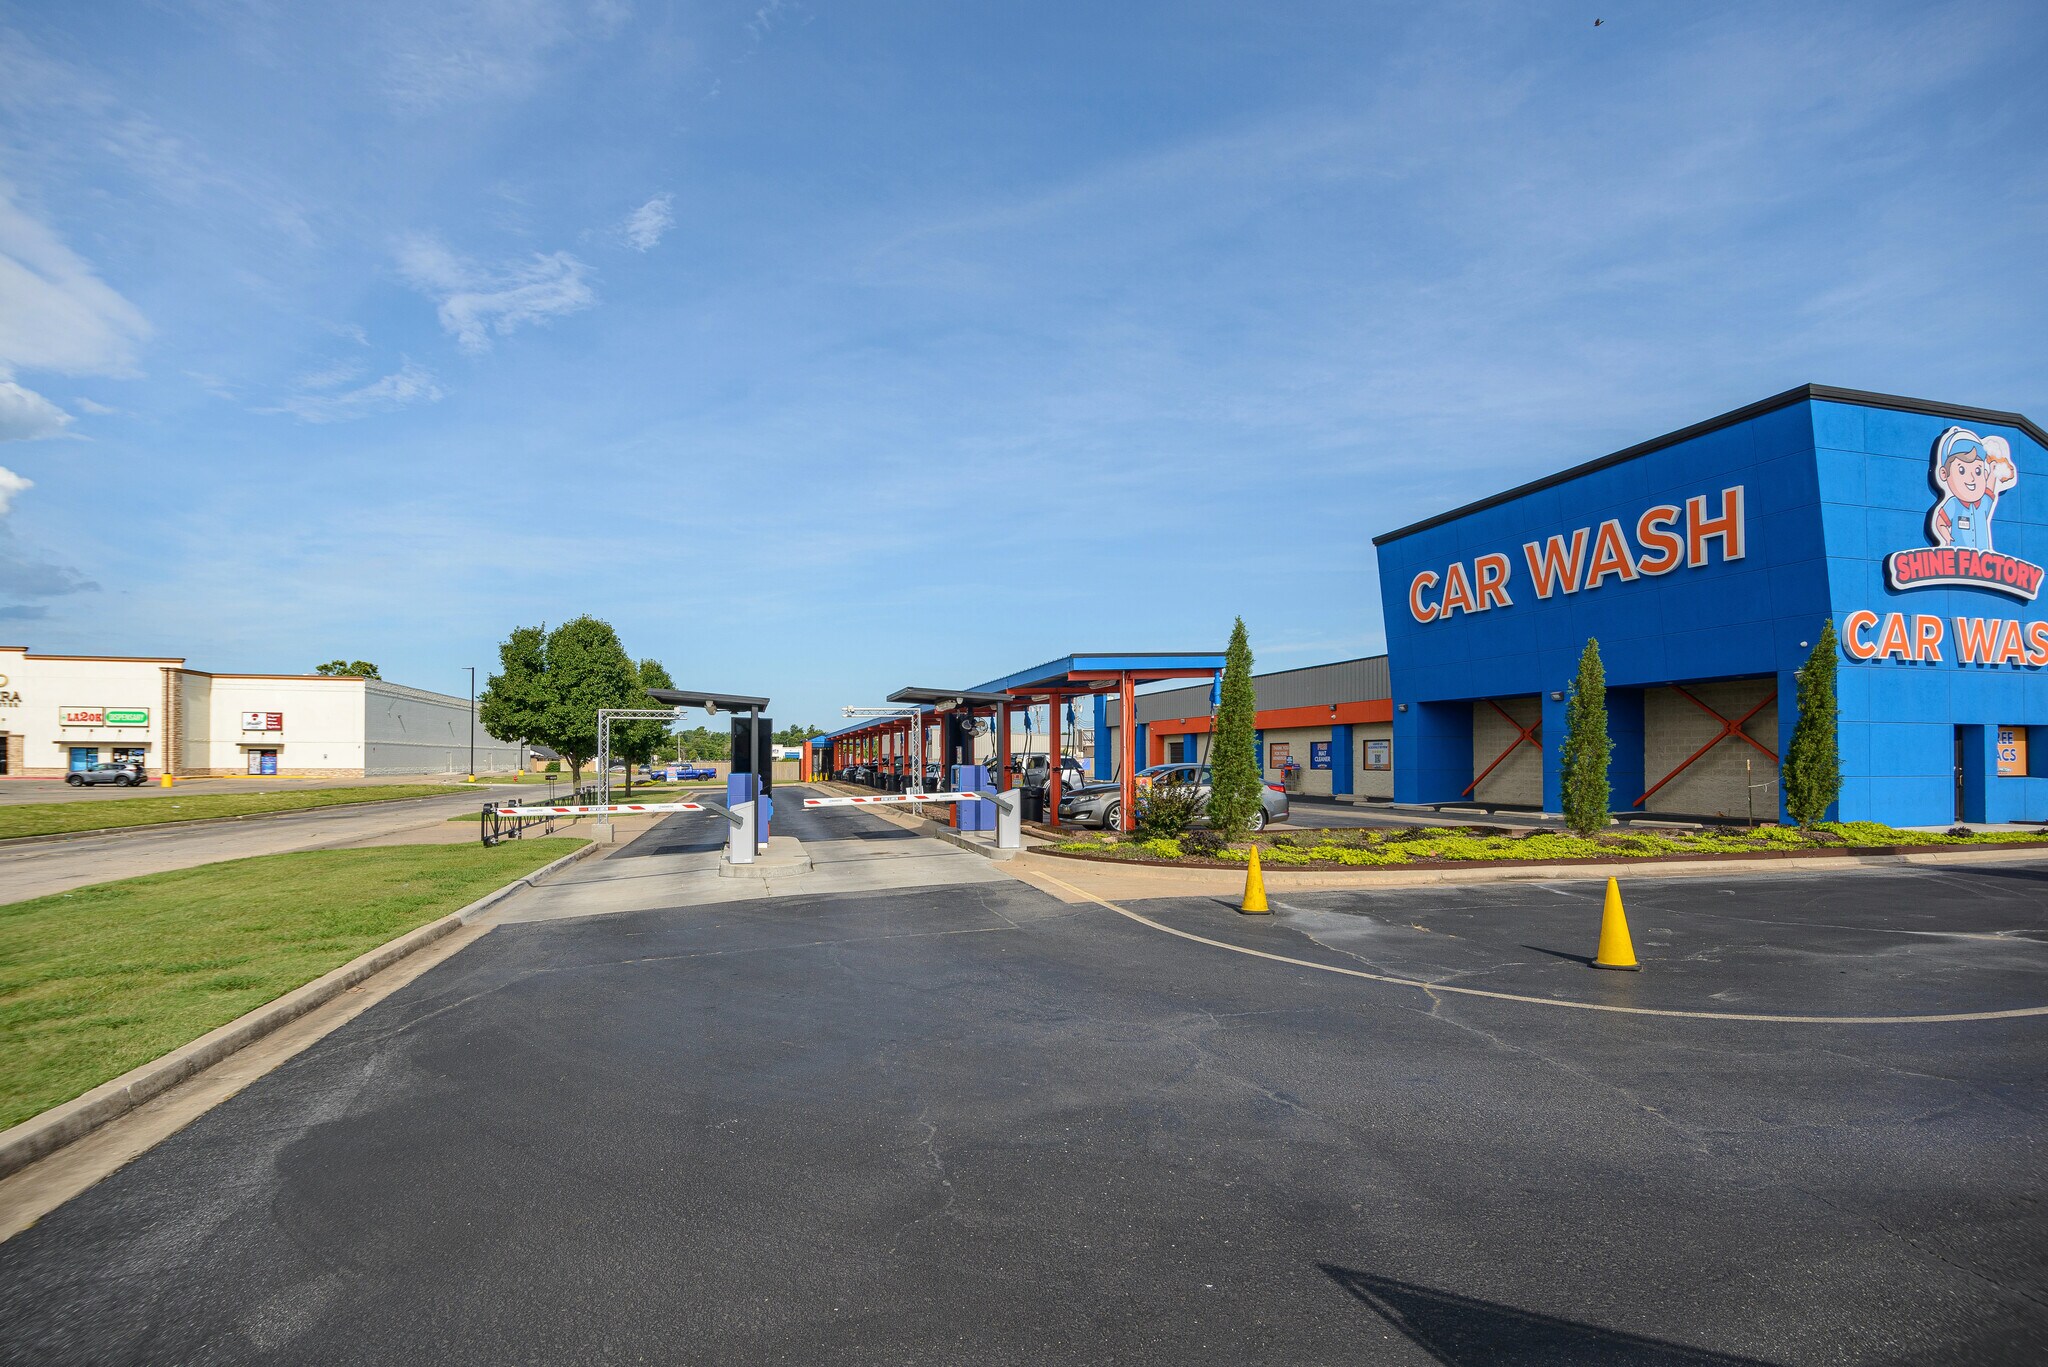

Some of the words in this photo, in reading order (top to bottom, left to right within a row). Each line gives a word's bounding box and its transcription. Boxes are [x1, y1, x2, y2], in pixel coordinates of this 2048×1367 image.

[1409, 552, 1513, 623] CAR
[1523, 485, 1745, 599] WASH
[1896, 549, 1956, 582] SHINE
[1958, 550, 2043, 593] FACTORY
[1842, 610, 1944, 662] CAR
[1951, 617, 2048, 667] WAS
